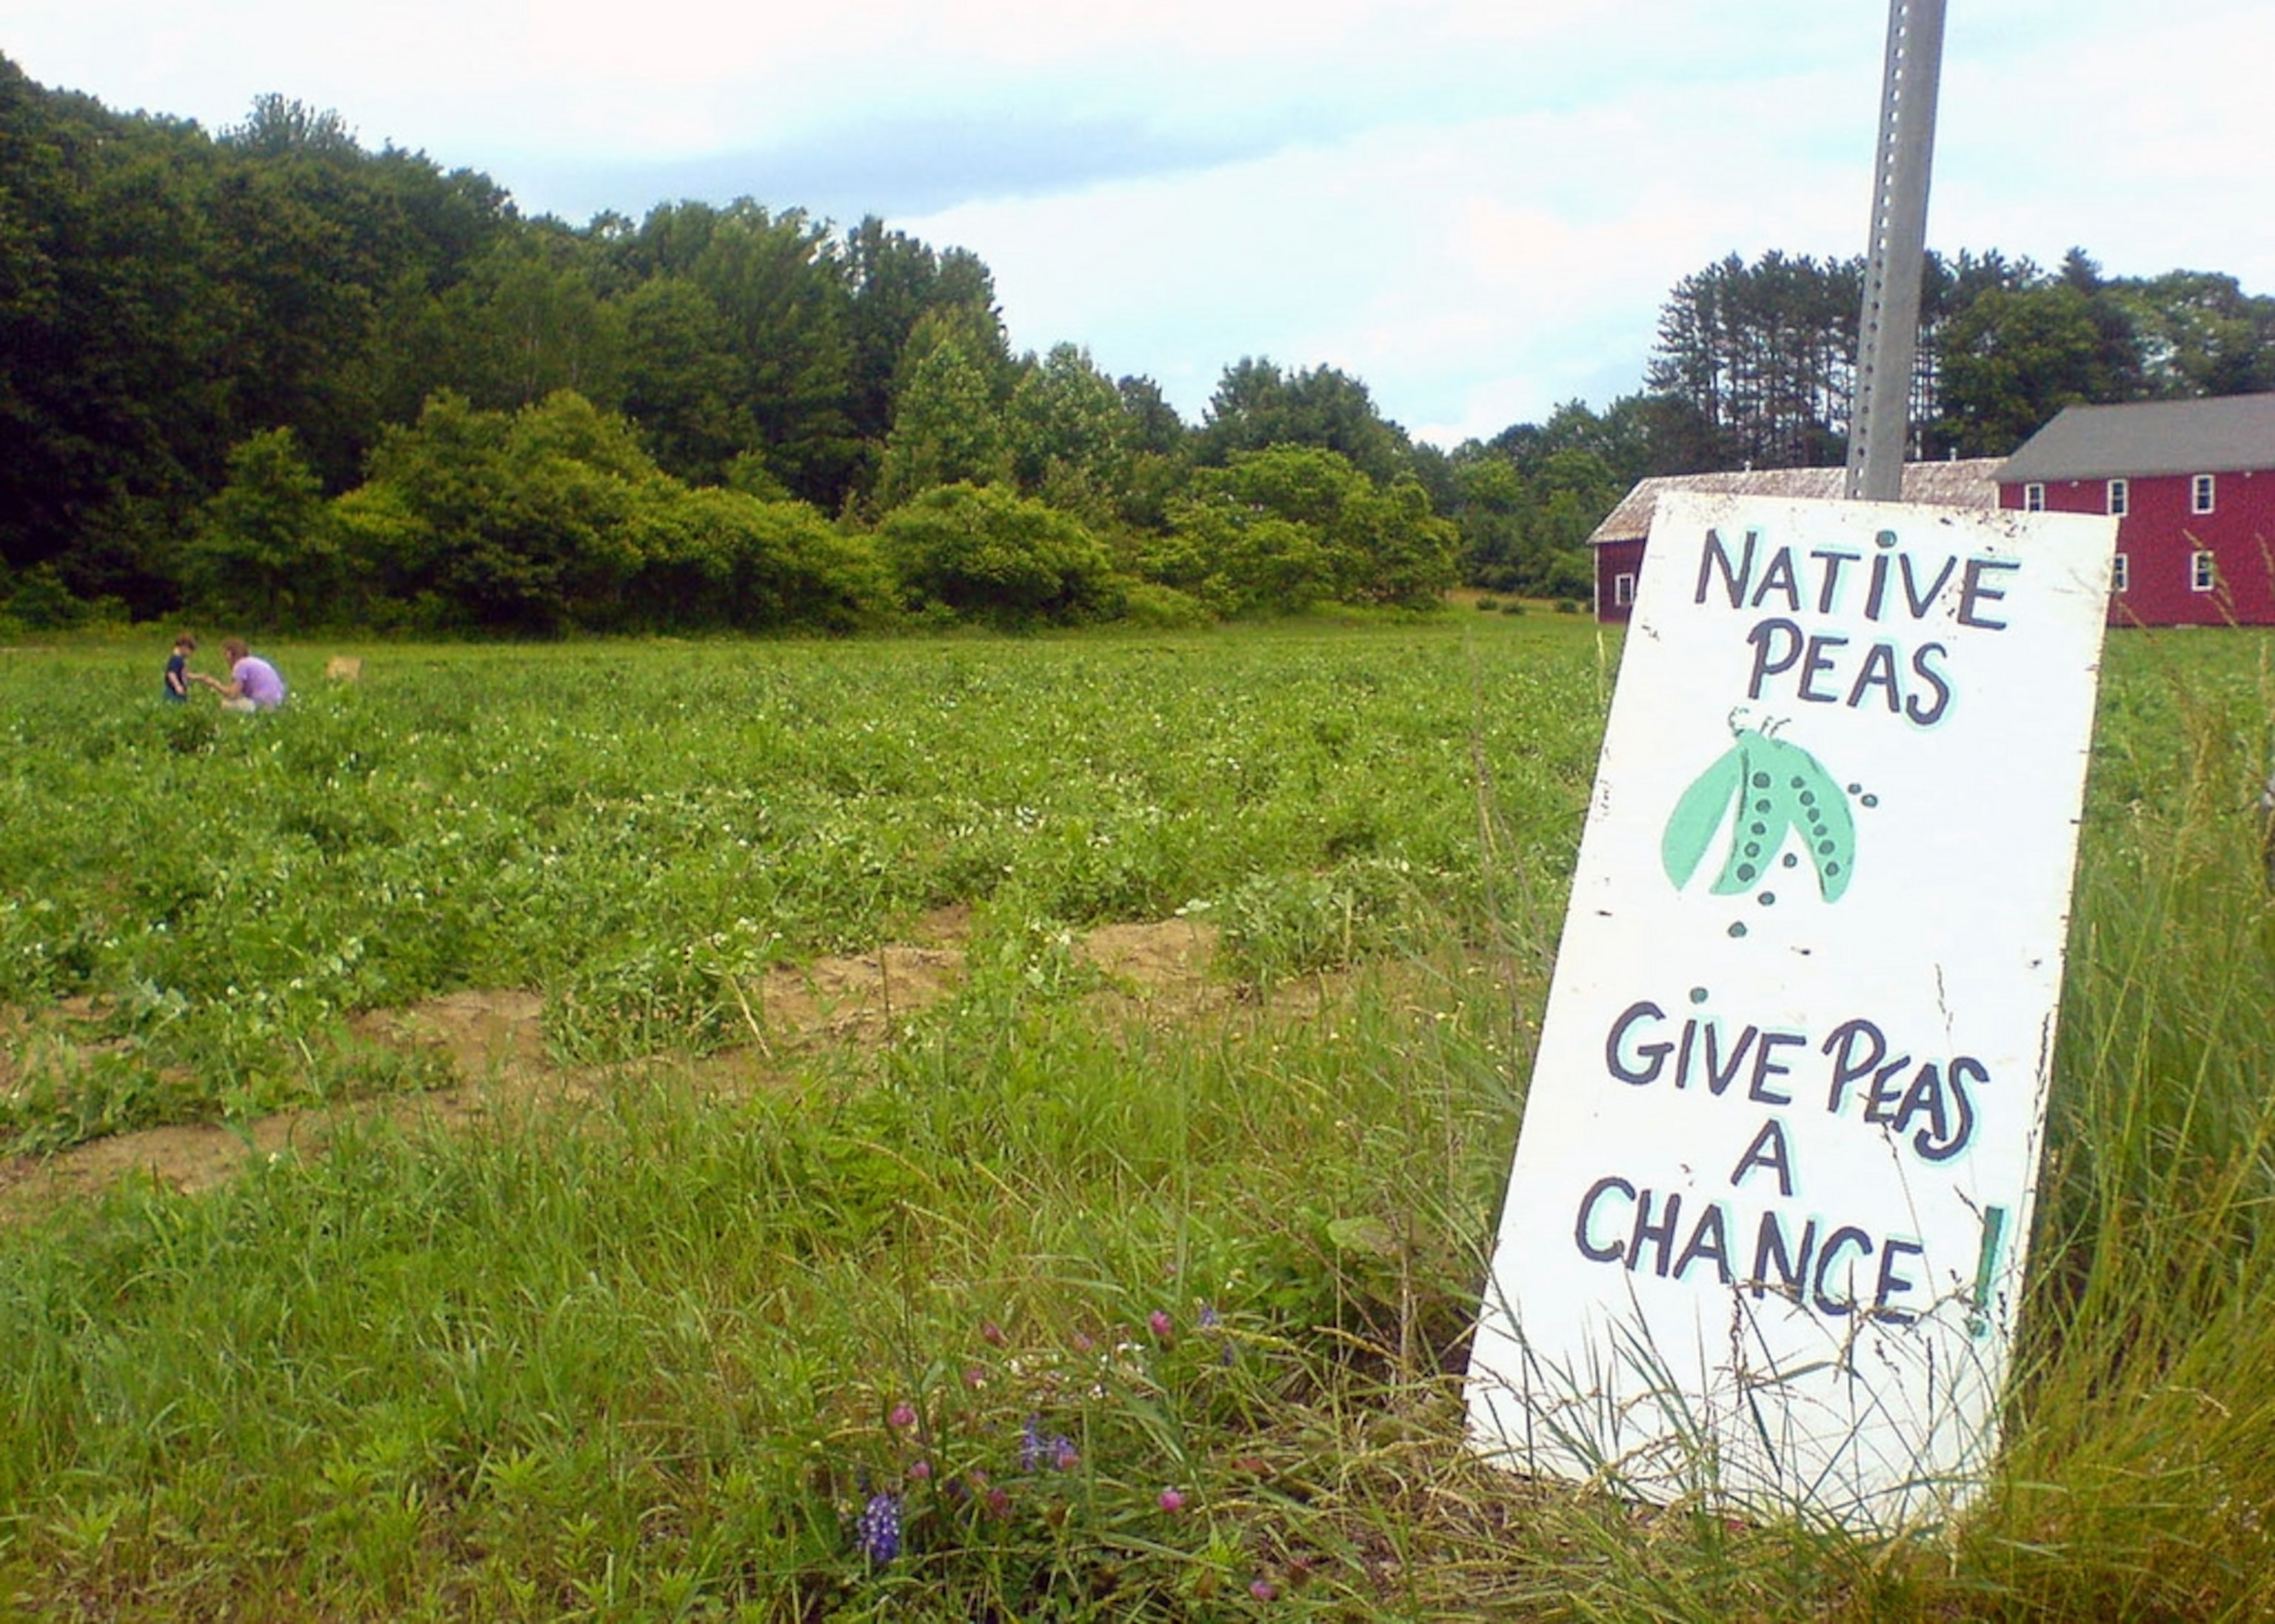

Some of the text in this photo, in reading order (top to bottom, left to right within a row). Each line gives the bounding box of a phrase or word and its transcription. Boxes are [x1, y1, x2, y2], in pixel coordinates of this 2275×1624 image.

[1746, 617, 1952, 726] PEAS
[1821, 1018, 1991, 1162] PEAS
[1730, 1118, 1794, 1197] A
